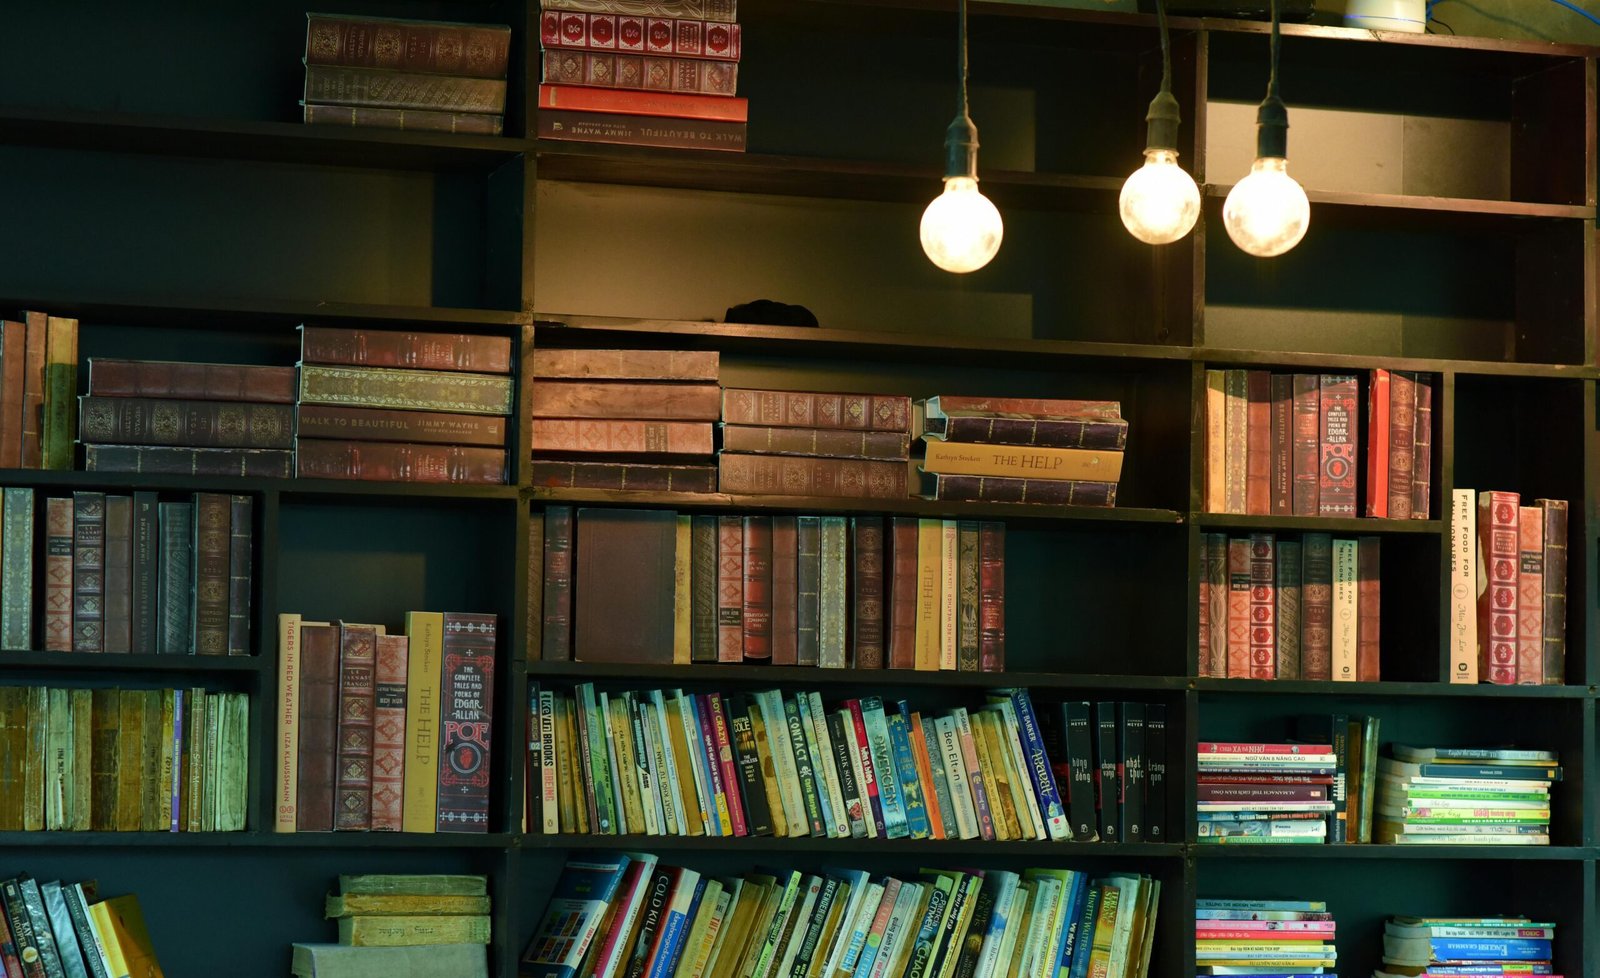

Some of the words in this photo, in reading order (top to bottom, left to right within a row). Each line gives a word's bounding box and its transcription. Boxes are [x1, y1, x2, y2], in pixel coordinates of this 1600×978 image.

[570, 126, 601, 134] WAYNE
[604, 128, 631, 136] JIMMY
[639, 127, 694, 138] BEAUTIFUL
[715, 133, 742, 141] WALK
[301, 416, 329, 425] WALK
[333, 418, 347, 426] TO
[351, 418, 408, 429] BEAUTIFUL
[448, 421, 478, 429] WAYNE
[935, 453, 957, 461] Kathryn
[992, 454, 1018, 466] THE
[1020, 455, 1063, 470] HELP
[1322, 444, 1354, 462] POE
[923, 565, 933, 598] HELP
[923, 600, 931, 620] THE
[286, 621, 294, 651] TIGERS
[423, 622, 431, 647] Kathryn
[286, 653, 293, 662] IN
[285, 664, 293, 681] RED
[284, 684, 292, 724] WEATHER
[419, 686, 431, 714] THE
[454, 699, 483, 709] EDGAR
[711, 696, 720, 713] BOY
[452, 711, 479, 719] ALLAN
[734, 721, 750, 732] COLE
[817, 704, 826, 732] LAUREN
[960, 718, 968, 733] CABOT
[1016, 693, 1029, 714] CLIVE
[1023, 714, 1036, 742] BARKER
[415, 718, 431, 764] HELP
[444, 722, 489, 750] POE
[715, 714, 728, 744] CRAZY!
[788, 715, 807, 762] CONTACT
[943, 730, 955, 751] Ben
[543, 733, 552, 766] BROOKS
[837, 743, 848, 768] DARK
[282, 751, 291, 801] KLAUSSMANN
[804, 777, 812, 793] Chris
[842, 768, 854, 792] SONG
[873, 733, 899, 814] DIVERGENT
[544, 776, 553, 801] BEING
[807, 793, 818, 818] Morphew
[650, 874, 669, 908] COLD
[817, 879, 836, 914] DEFENDER
[884, 882, 897, 905] JANICE
[922, 889, 943, 932] Cornwell
[931, 898, 946, 927] Patricia
[1084, 889, 1097, 920] MINETTE
[1100, 890, 1111, 921] STRONG
[1107, 890, 1118, 923] TERENCE
[12, 916, 26, 947] HOOPER
[21, 921, 31, 937] KAY
[643, 909, 658, 932] KILL
[707, 916, 720, 931] THE
[875, 918, 884, 930] LEE
[1046, 909, 1054, 930] PELZER
[80, 925, 94, 954] MICHAEL
[1079, 921, 1091, 951] WALTERS
[759, 952, 767, 969] VALLEY
[863, 950, 872, 963] THE
[1478, 943, 1508, 955] ENGLISH
[909, 946, 927, 978] CHAO
